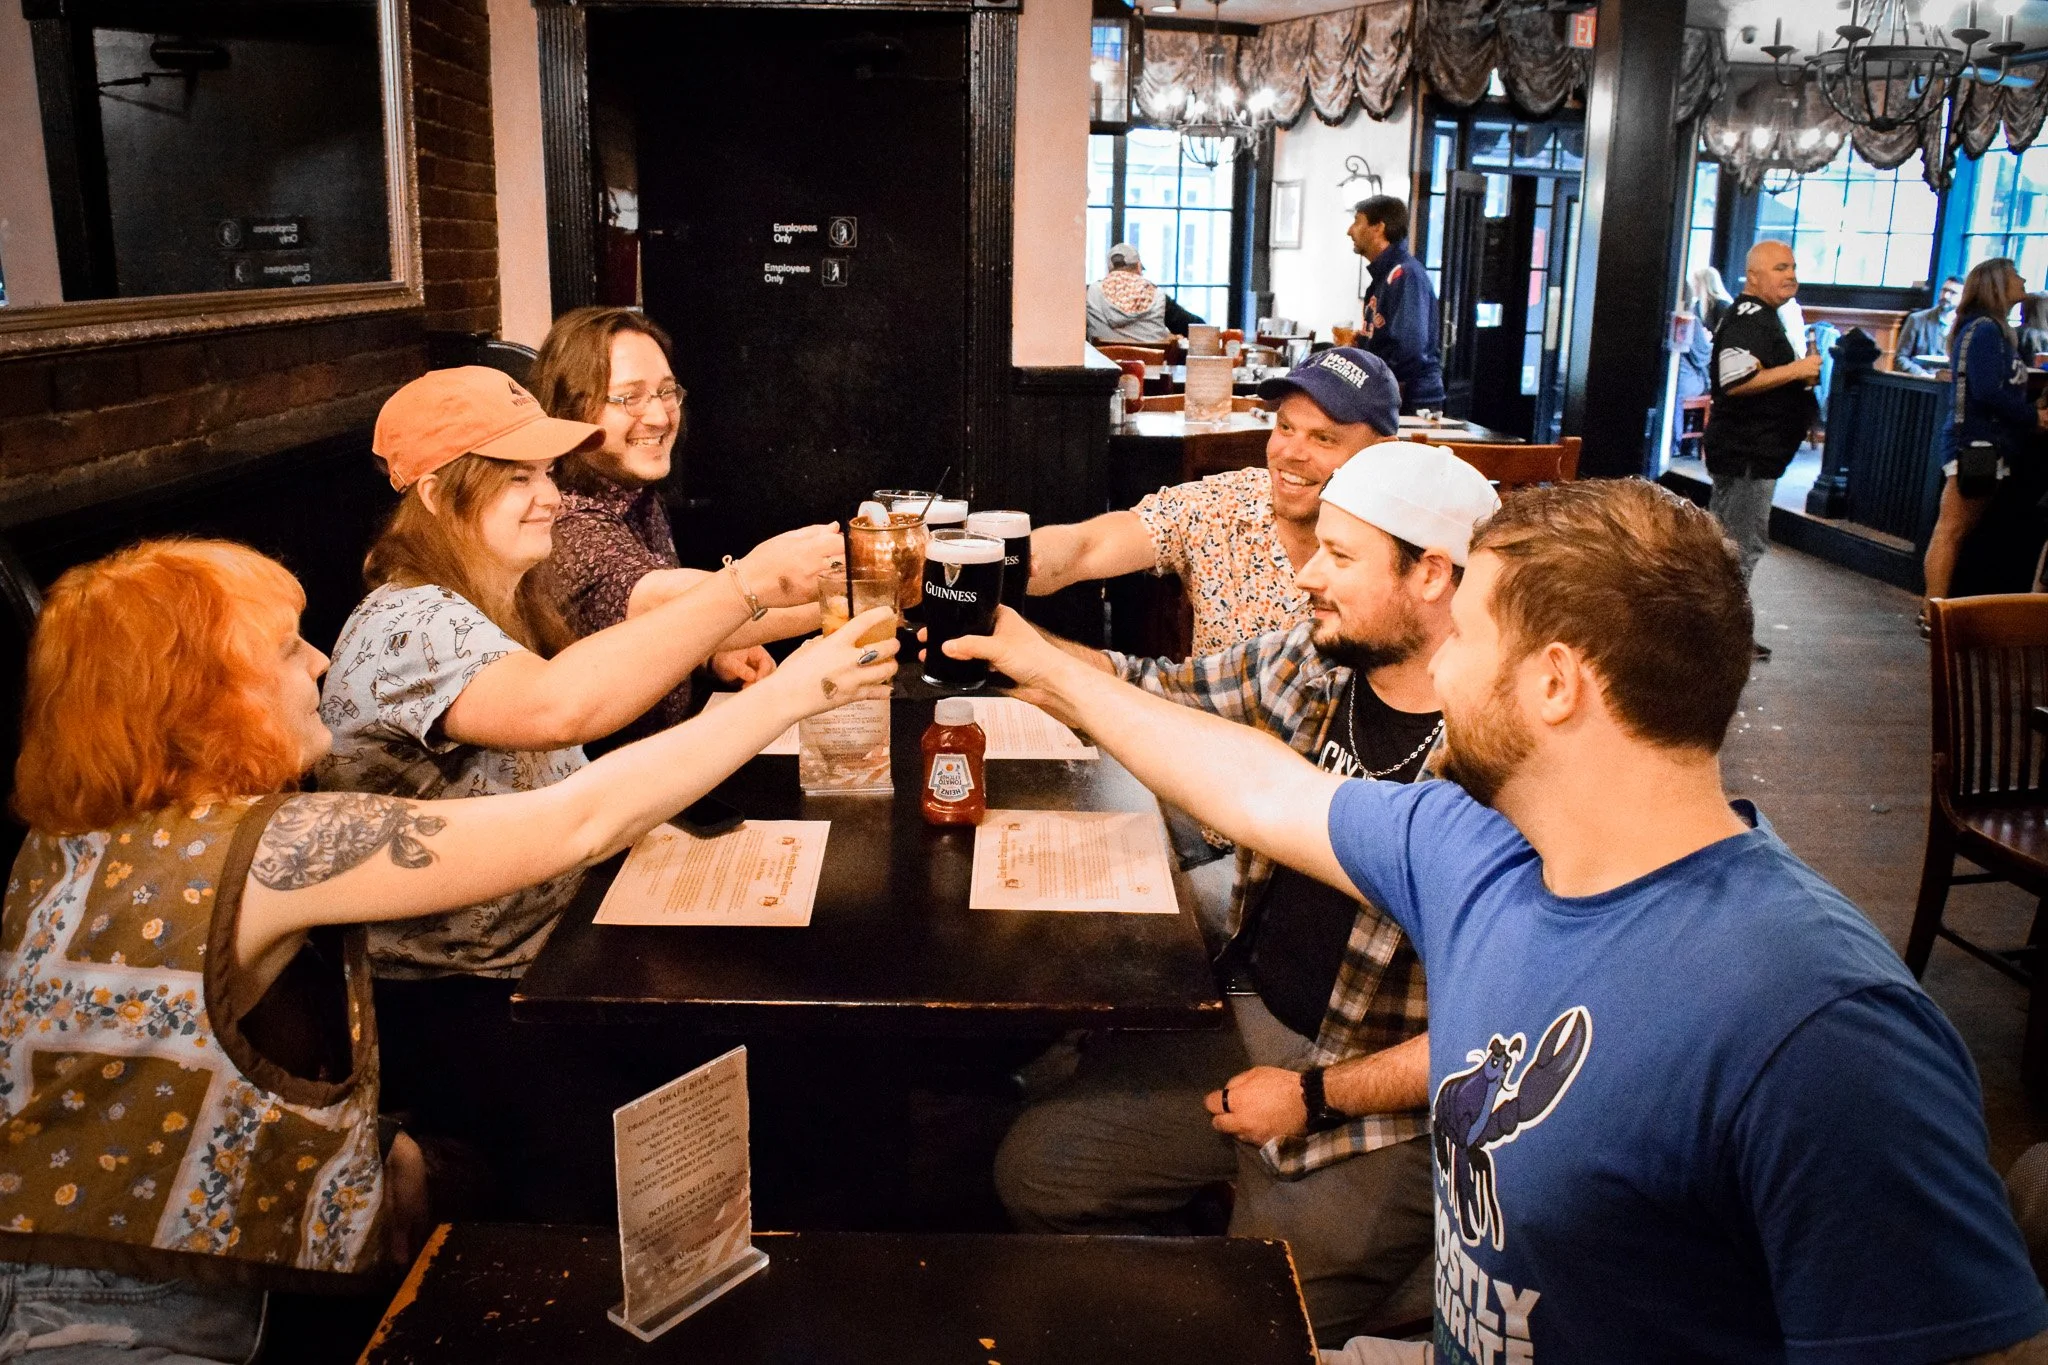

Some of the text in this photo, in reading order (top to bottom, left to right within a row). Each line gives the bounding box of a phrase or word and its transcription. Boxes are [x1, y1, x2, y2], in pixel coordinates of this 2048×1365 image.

[1577, 15, 1593, 44] EX
[773, 223, 818, 233] Employees
[773, 234, 793, 244] Only
[764, 263, 811, 274] Employees
[764, 274, 785, 285] Only
[1737, 301, 1763, 316] 97
[1325, 352, 1370, 380] MOSTLY
[925, 580, 978, 602] GUINNESS
[940, 788, 961, 796] HEINZ
[1434, 1195, 1541, 1340] OSTLY
[1435, 1260, 1534, 1365] CURAT
